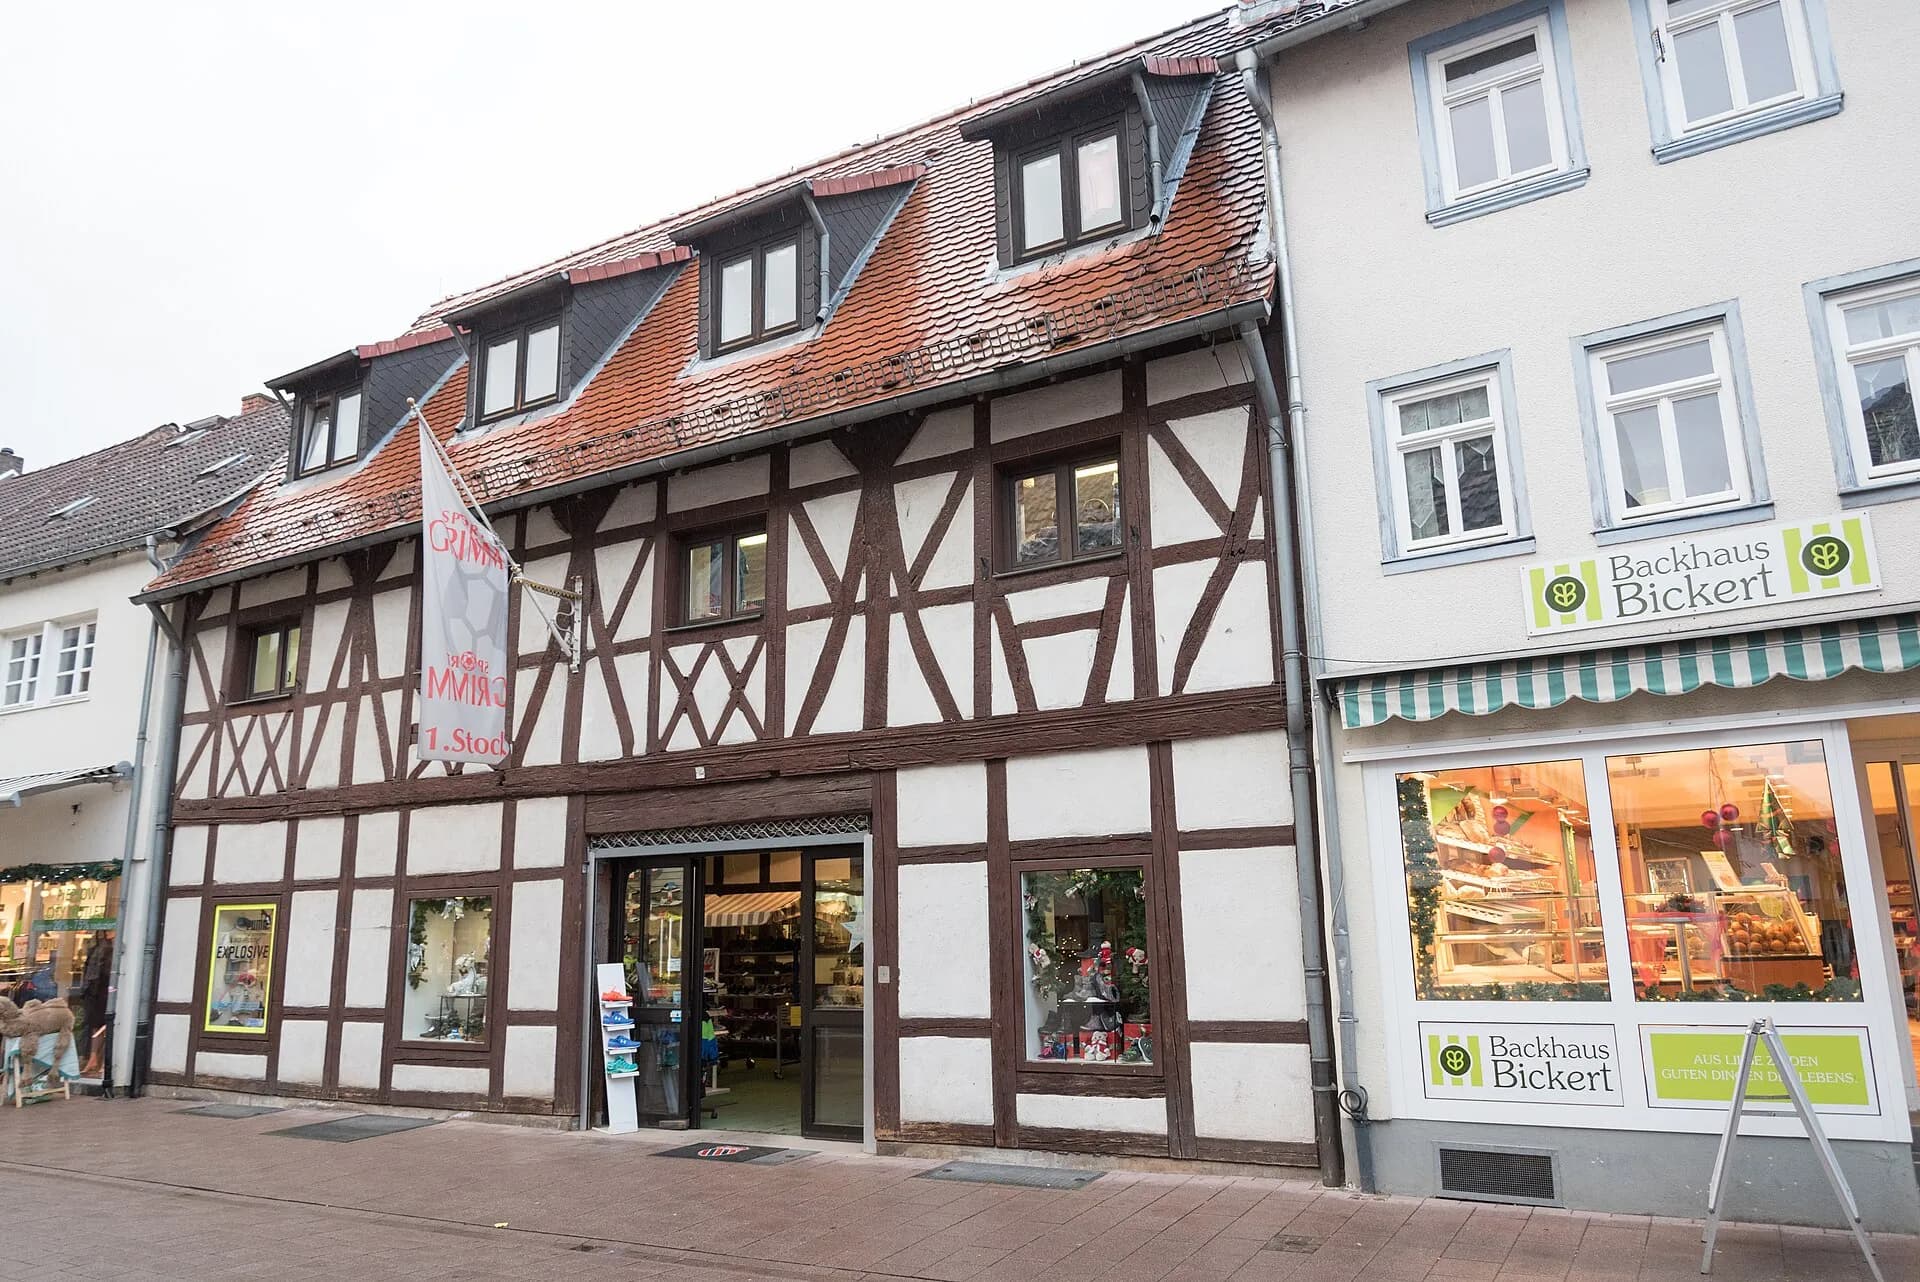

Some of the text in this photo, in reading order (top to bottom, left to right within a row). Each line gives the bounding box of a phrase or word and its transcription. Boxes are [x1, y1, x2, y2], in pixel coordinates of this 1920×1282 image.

[1608, 541, 1771, 582] Backhaus
[1612, 562, 1777, 618] Bickert
[217, 945, 269, 959] EXPLOSIVE
[1489, 1035, 1610, 1061] Backhaus
[1694, 1054, 1721, 1065] AUS
[1492, 1060, 1614, 1093] Bickert
[1661, 1069, 1708, 1080] GUTEN
[1711, 1070, 1763, 1082] DINEN
